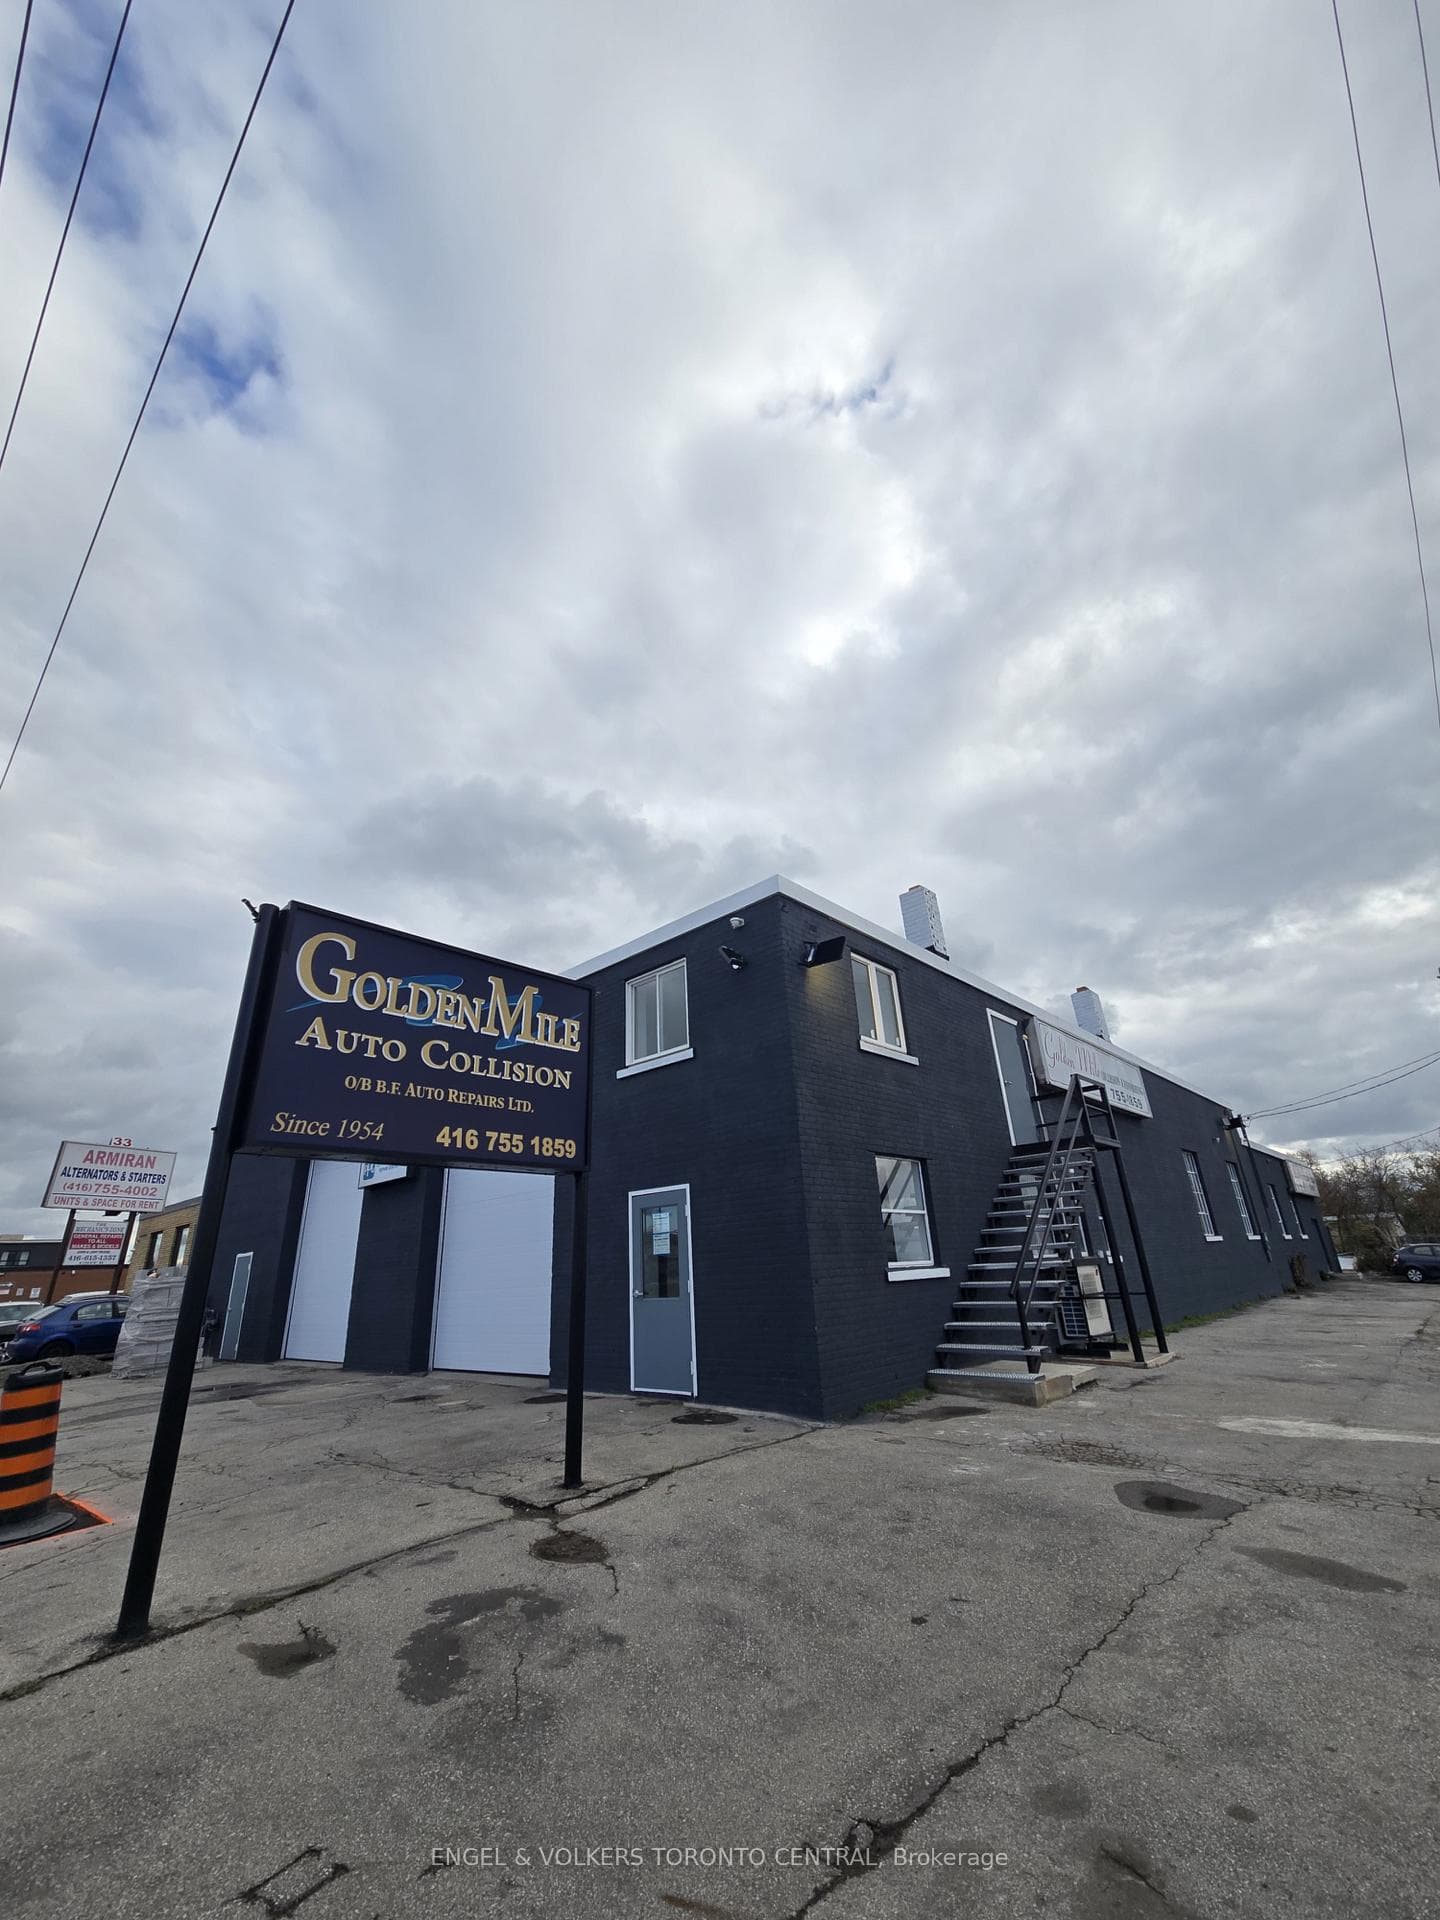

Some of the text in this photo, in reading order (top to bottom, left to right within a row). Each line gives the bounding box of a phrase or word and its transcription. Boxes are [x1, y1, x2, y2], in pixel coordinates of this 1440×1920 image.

[295, 1017, 573, 1090] AUTO COLLISION
[344, 1075, 534, 1113] O/B B.F. AUTO REPAIRS LTD.
[270, 1112, 385, 1142] Since 1954
[436, 1126, 577, 1159] 416 755 1859
[82, 1149, 157, 1169] ARMIRAN
[61, 1166, 167, 1185] ALTERNATORS & STARTERS
[63, 1182, 158, 1197] (416) 755-4002
[54, 1196, 160, 1210] UNITS & SPACE FOR RENT
